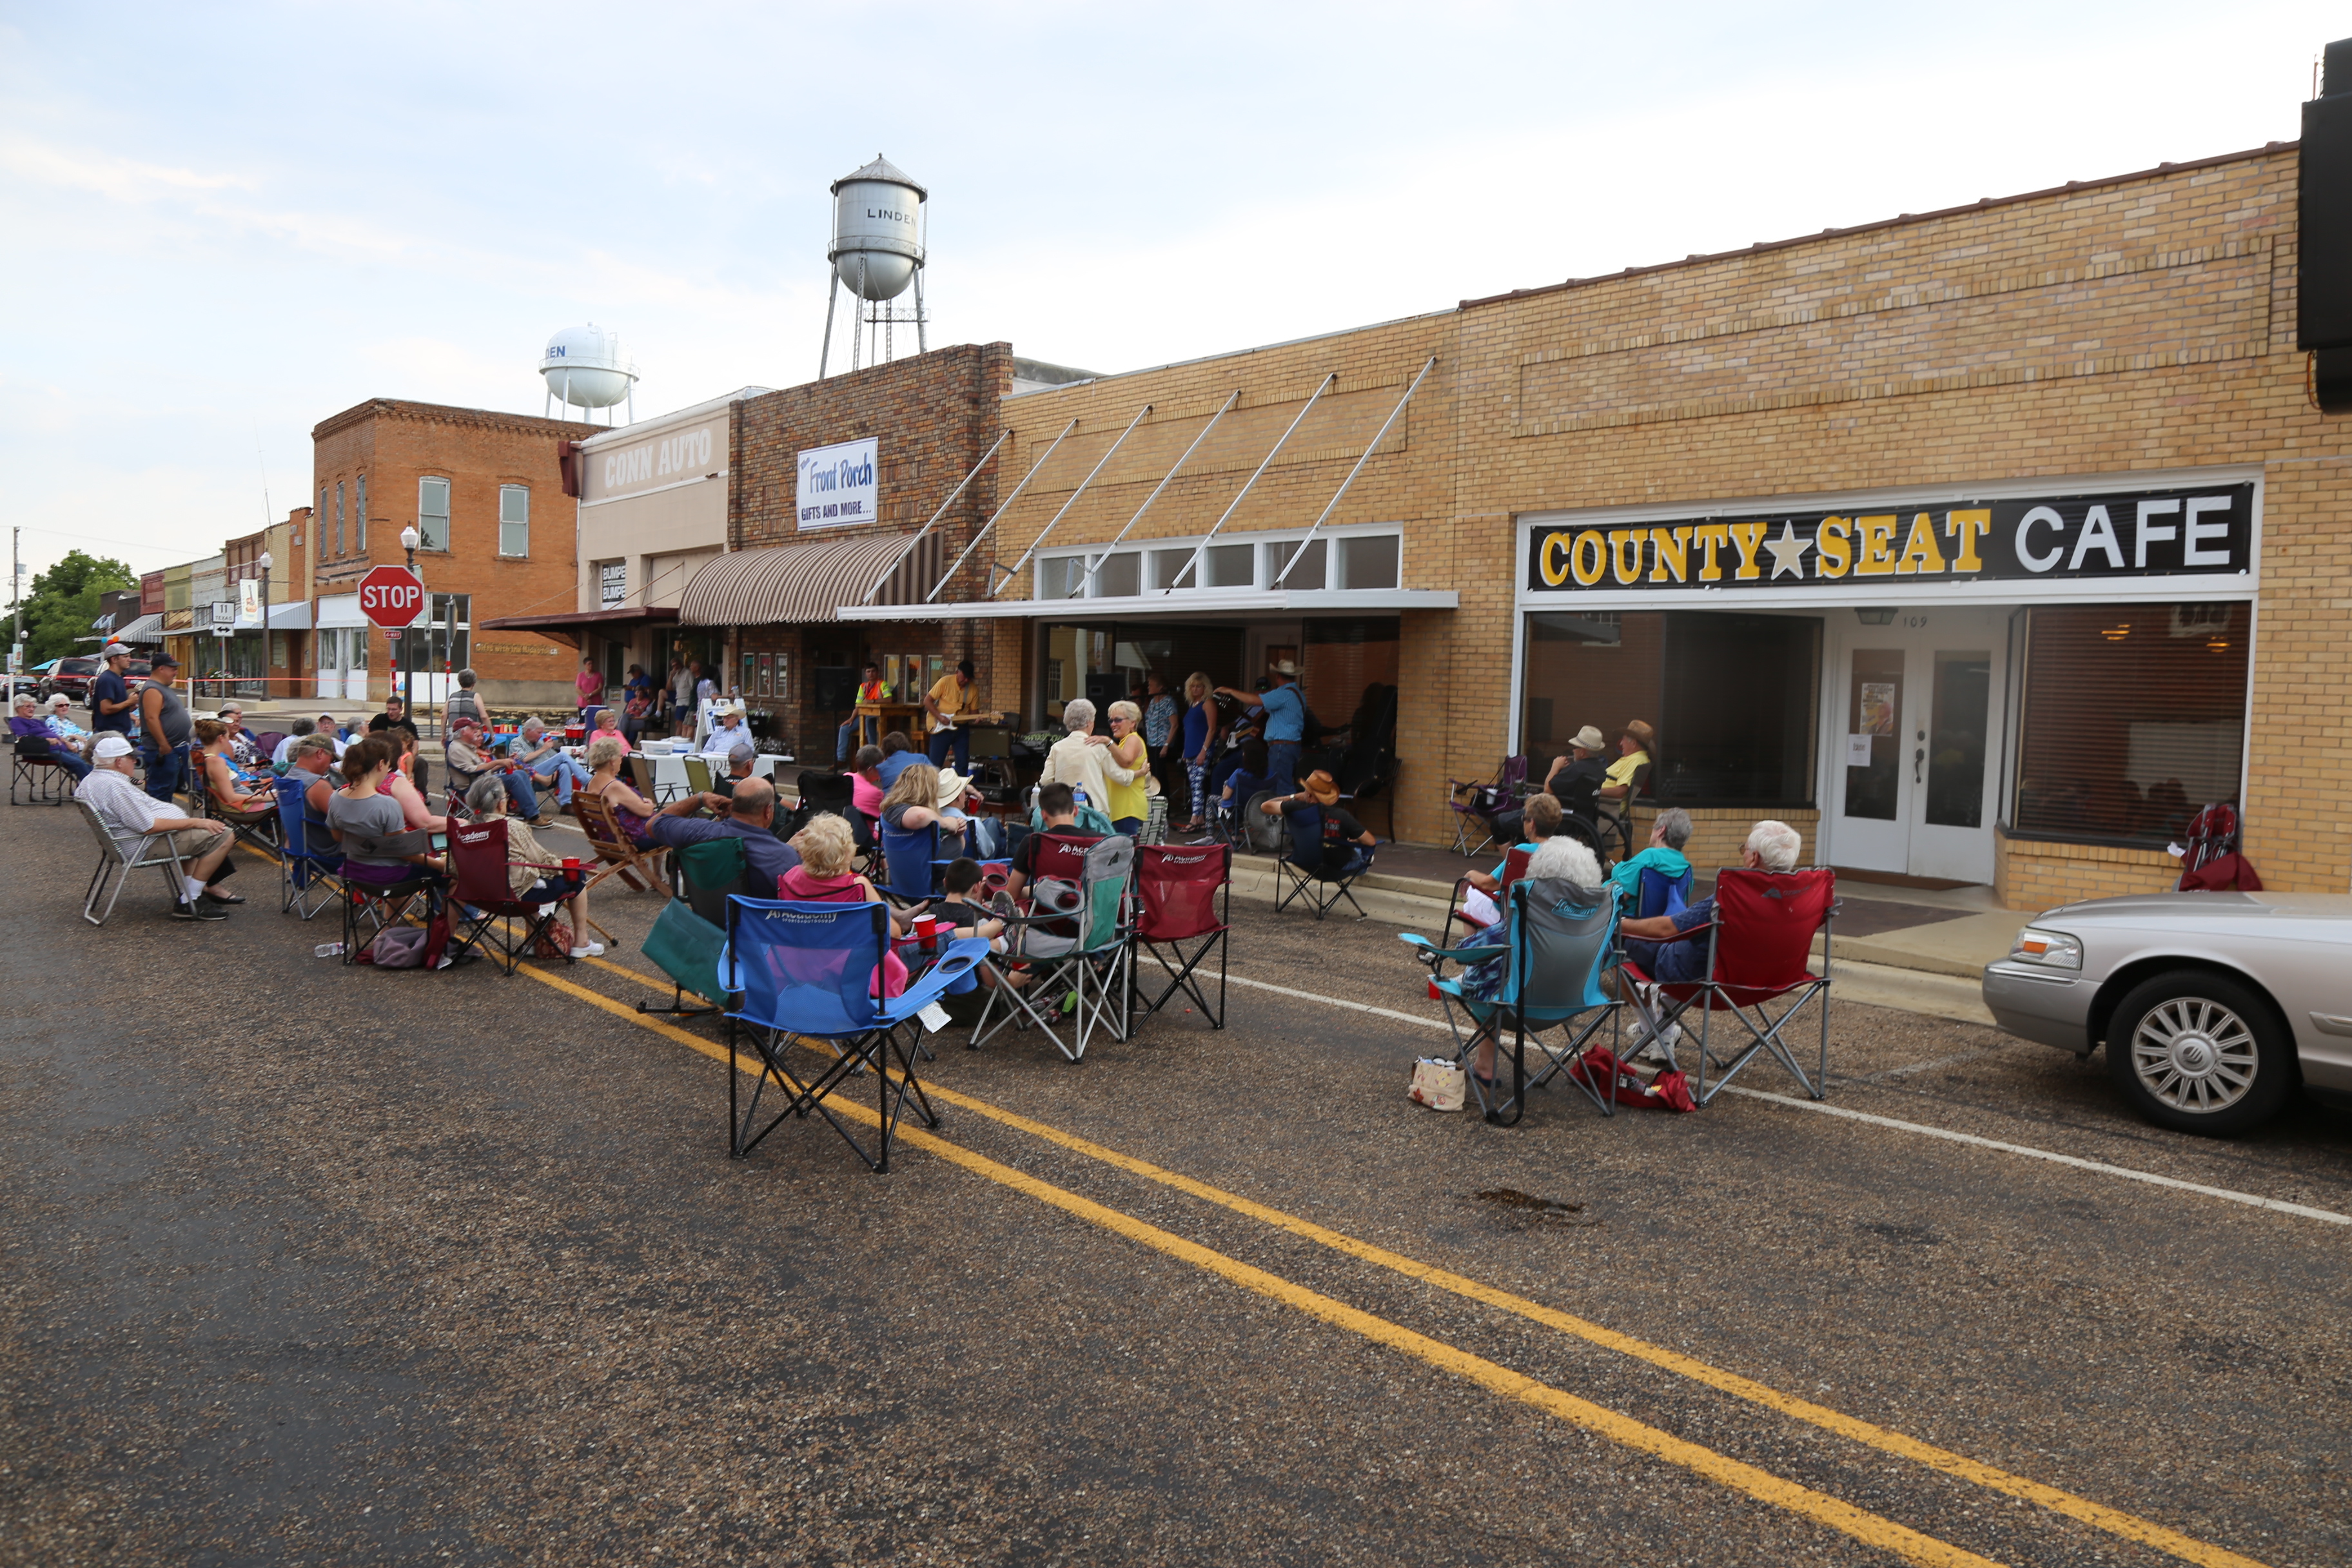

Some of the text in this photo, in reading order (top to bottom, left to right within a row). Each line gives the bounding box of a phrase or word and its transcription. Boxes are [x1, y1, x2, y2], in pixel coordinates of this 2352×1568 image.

[867, 208, 916, 228] LINDEN
[546, 345, 566, 359] DEN
[605, 428, 711, 488] CONN AUTO
[810, 452, 872, 494] Front Porch
[801, 505, 821, 521] GIFTS
[823, 504, 838, 518] AND
[1540, 495, 2232, 586] COUNTY SEAT CAFE
[603, 565, 625, 580] BUMPE
[363, 585, 420, 609] STOP
[603, 585, 625, 600] BUMPE
[220, 604, 228, 613] 11
[1904, 616, 1928, 629] 109
